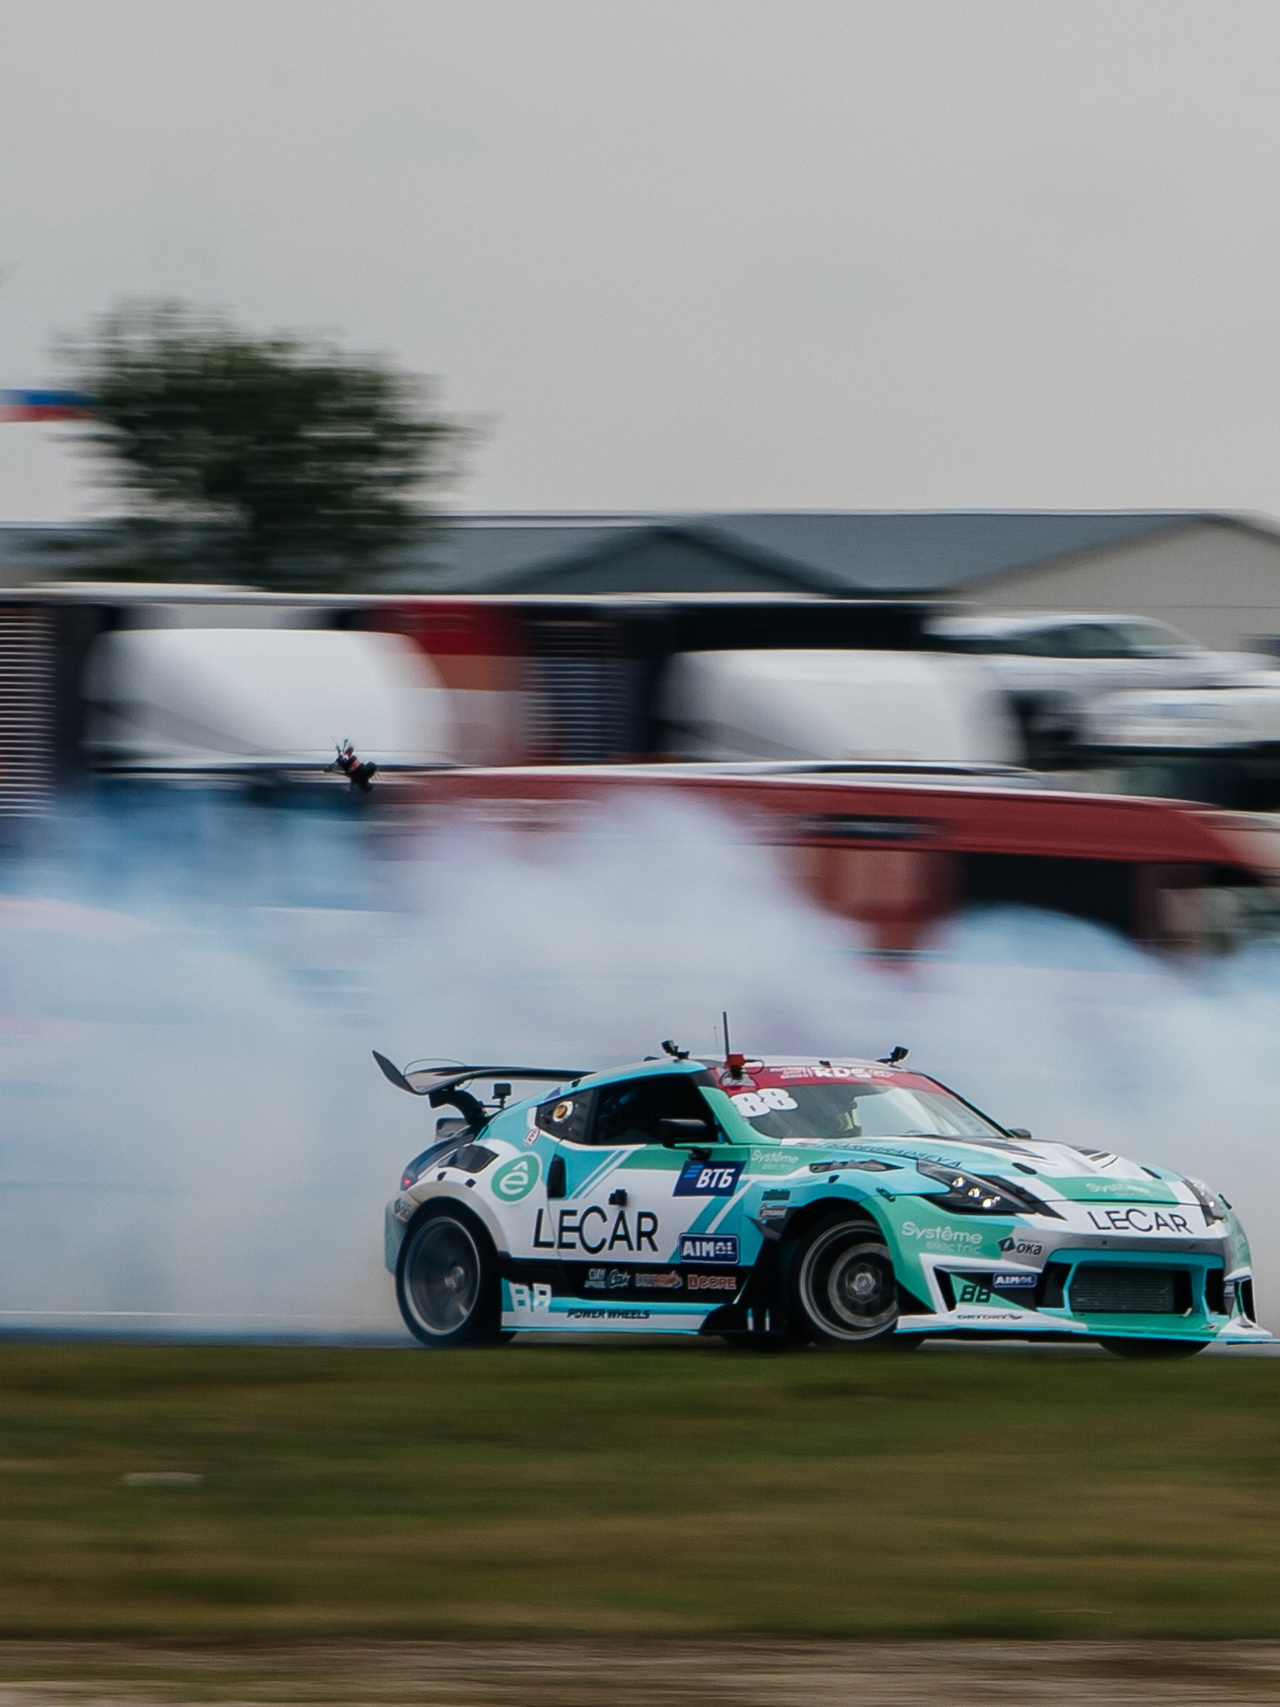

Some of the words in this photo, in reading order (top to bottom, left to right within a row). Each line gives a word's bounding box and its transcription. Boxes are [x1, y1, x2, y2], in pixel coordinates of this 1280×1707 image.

[811, 1066, 872, 1078] RDS
[730, 1088, 798, 1117] 88
[696, 1168, 736, 1188] ВТБ
[533, 1205, 659, 1255] LECAR
[1087, 1208, 1194, 1234] LECAR
[958, 1285, 992, 1304] 88
[567, 1308, 605, 1319] POWER
[607, 1309, 651, 1319] WHEELS
